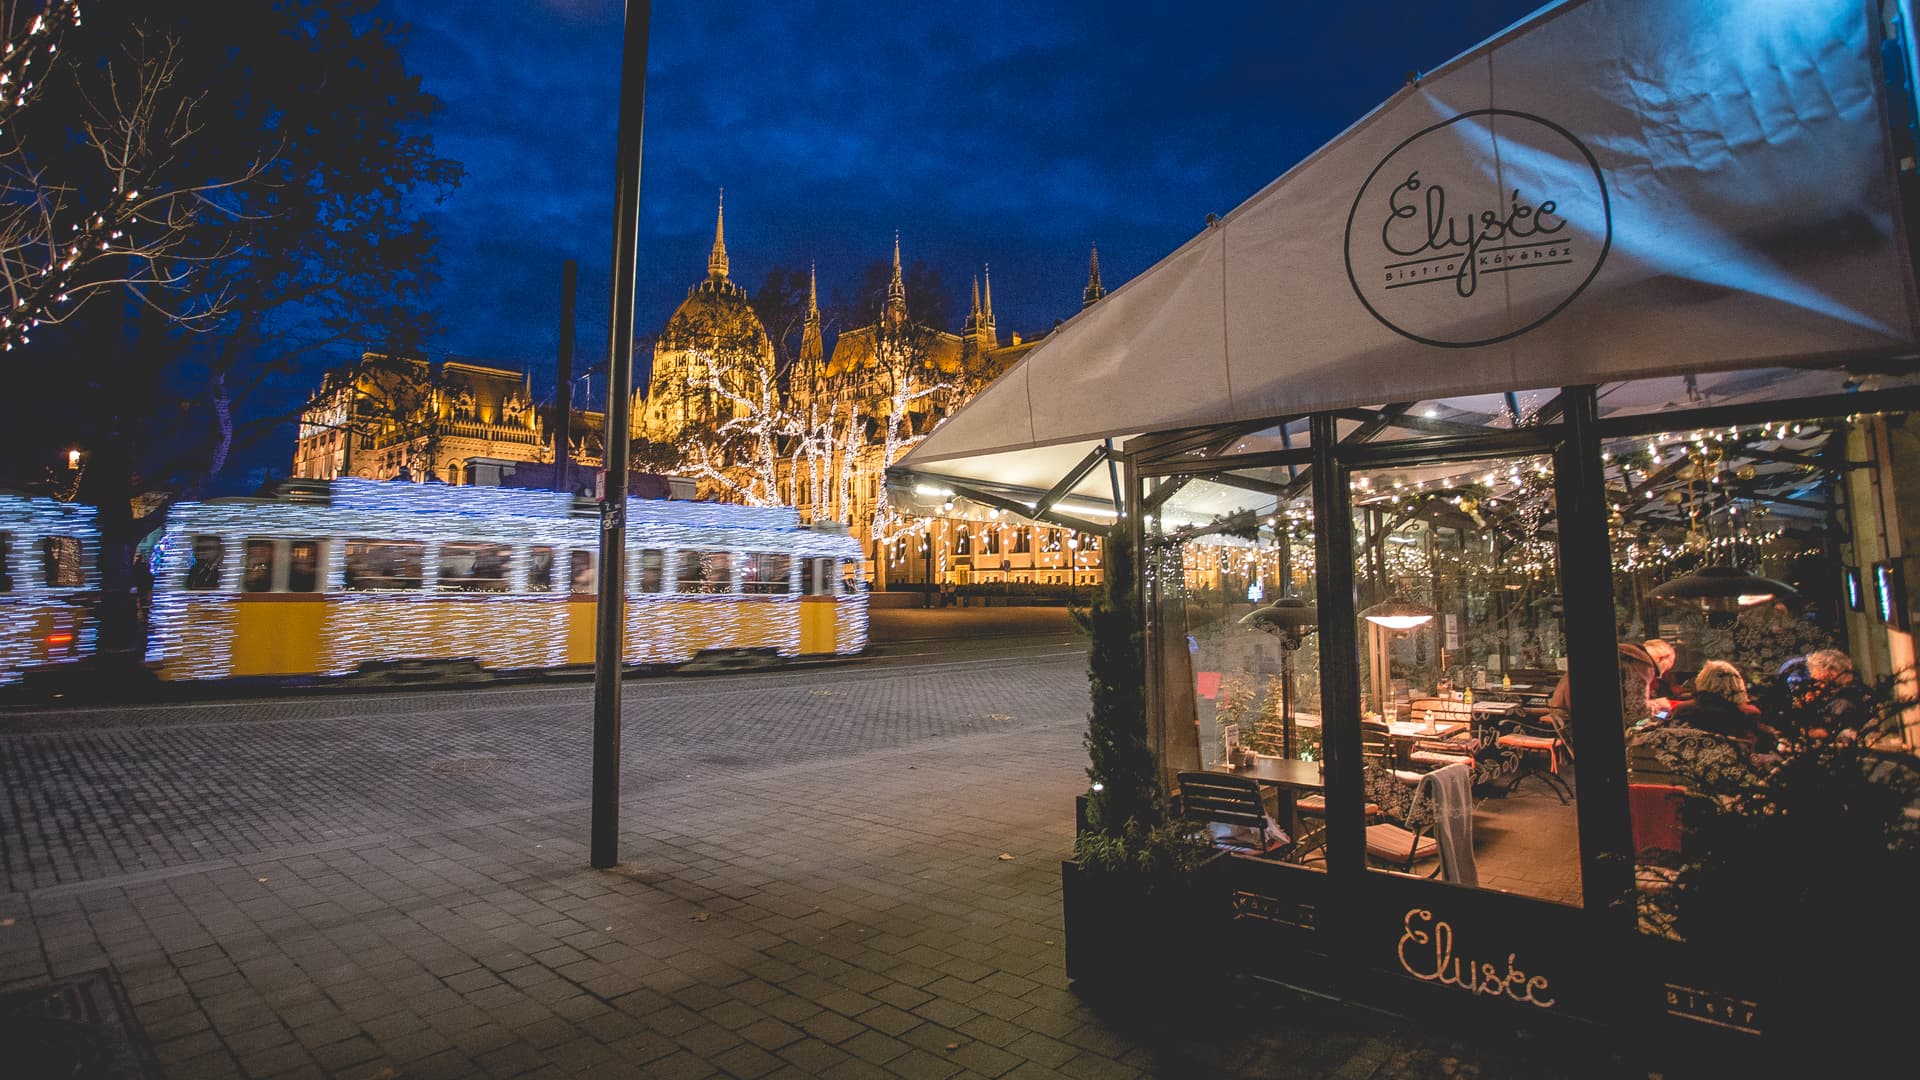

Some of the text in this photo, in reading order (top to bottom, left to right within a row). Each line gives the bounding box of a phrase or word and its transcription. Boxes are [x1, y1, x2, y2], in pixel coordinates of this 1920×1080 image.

[1385, 246, 1571, 282] Bistro Kávéház
[1666, 991, 1754, 1024] Bistr
